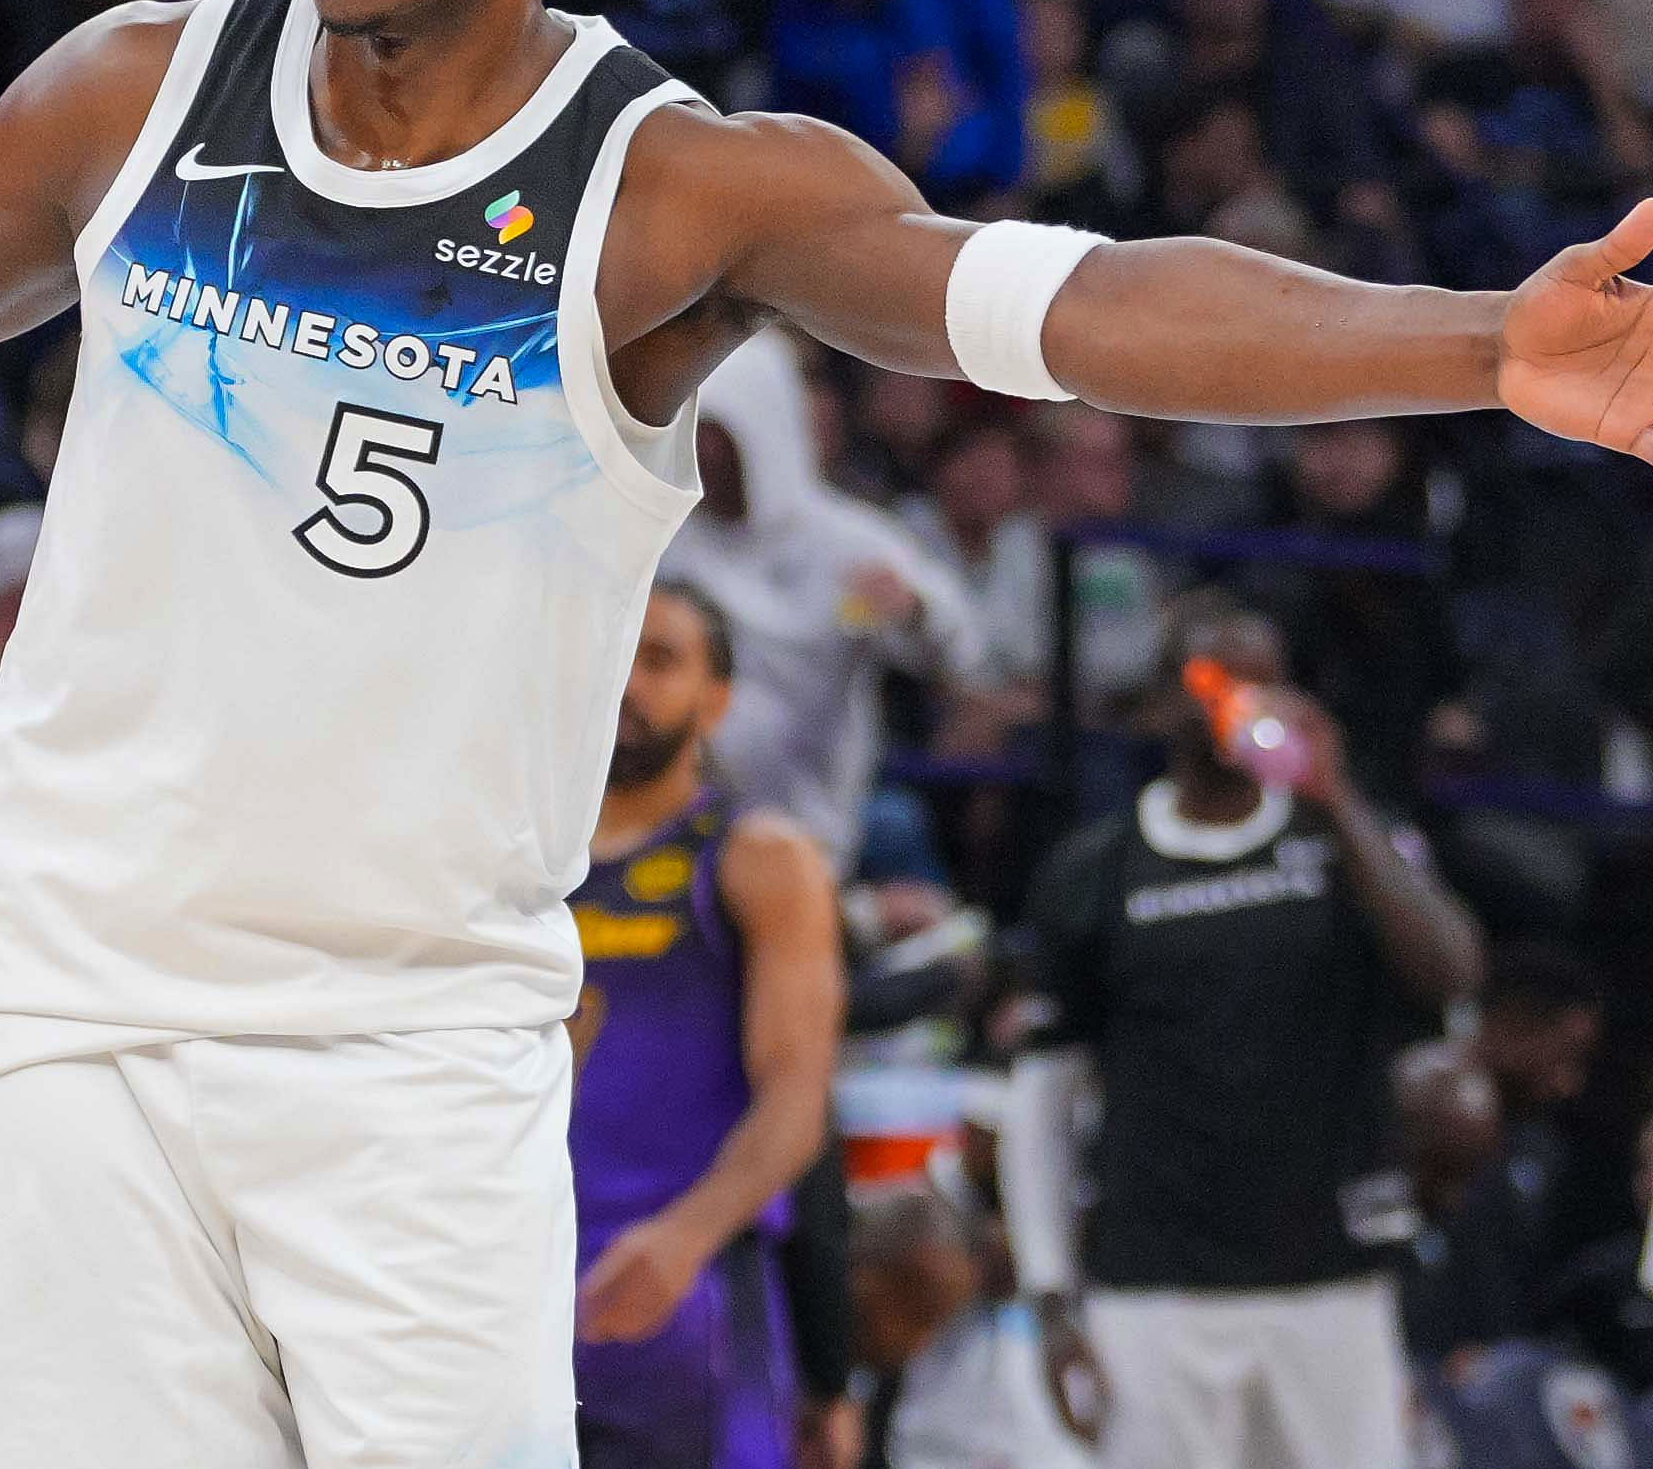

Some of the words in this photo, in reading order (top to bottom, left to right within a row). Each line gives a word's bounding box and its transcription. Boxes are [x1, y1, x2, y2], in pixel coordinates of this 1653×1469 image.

[434, 237, 557, 286] sezzle
[120, 262, 518, 405] MINNESOTA
[290, 401, 445, 579] 5
